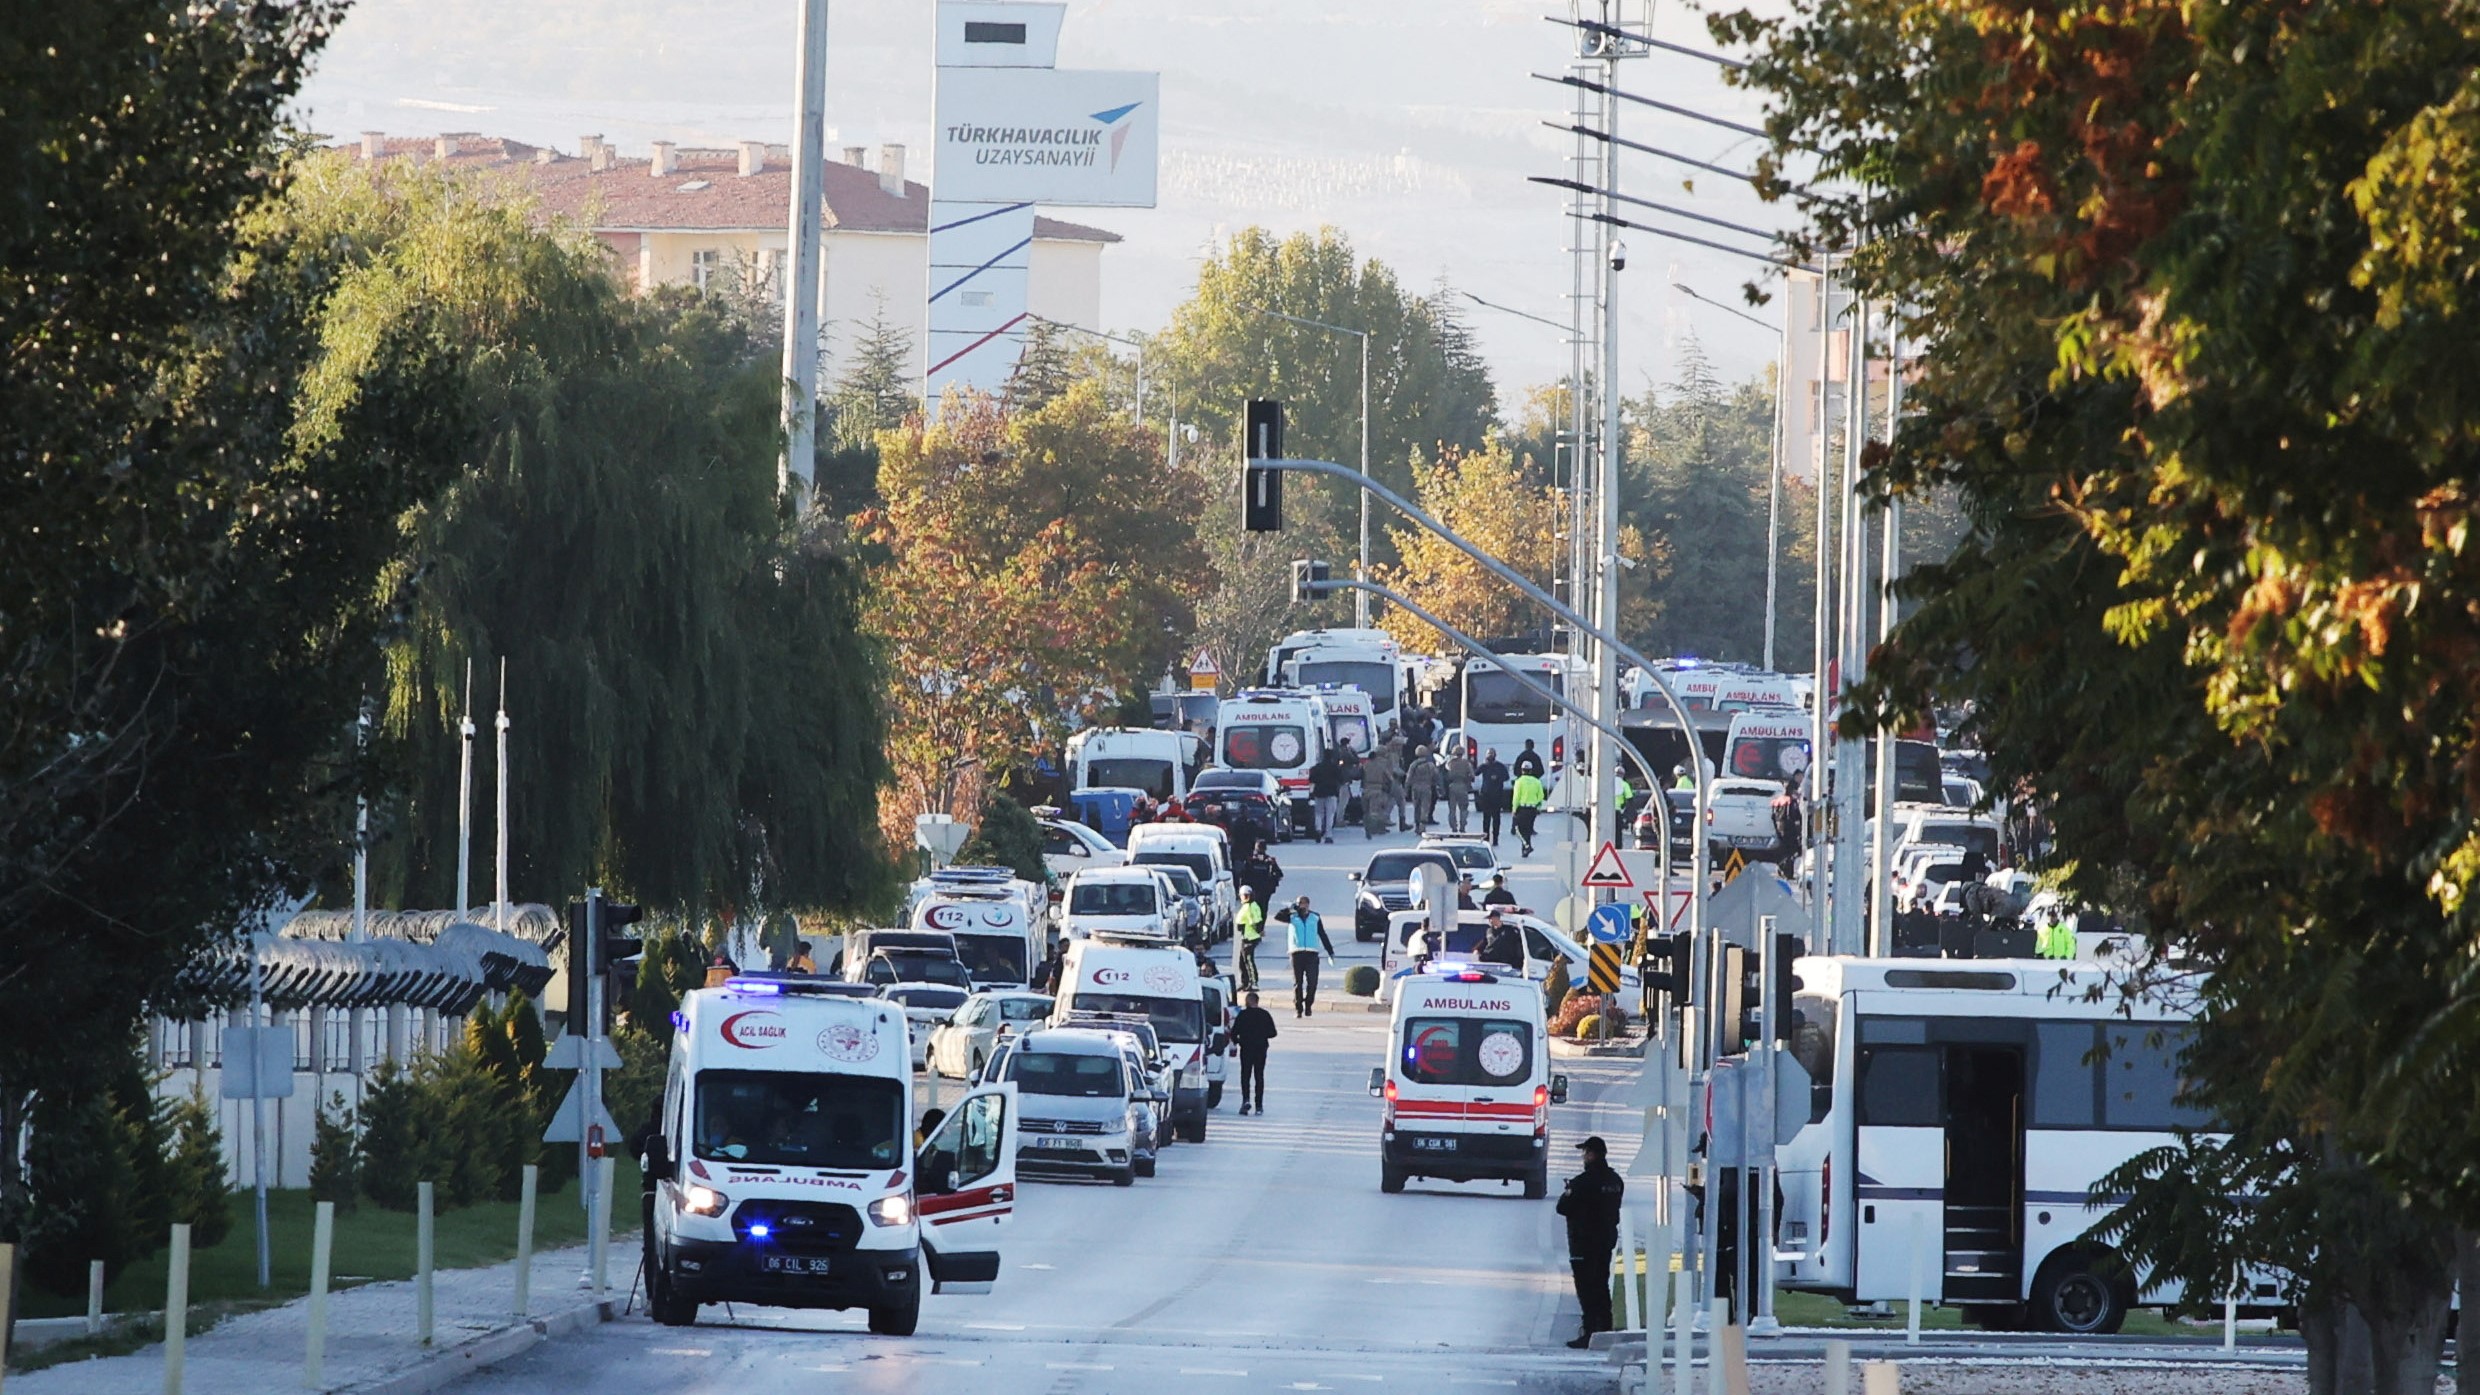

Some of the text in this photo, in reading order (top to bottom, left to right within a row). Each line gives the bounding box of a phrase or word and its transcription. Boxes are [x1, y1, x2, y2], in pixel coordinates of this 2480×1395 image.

[1725, 690, 1782, 702] AMBULANS
[1234, 712, 1291, 721] AMBULANS
[1740, 726, 1804, 737] AMBULANS
[938, 911, 964, 922] 112
[1105, 972, 1130, 981] 112
[1423, 998, 1511, 1011] AMBULANS
[768, 1257, 780, 1269] 06
